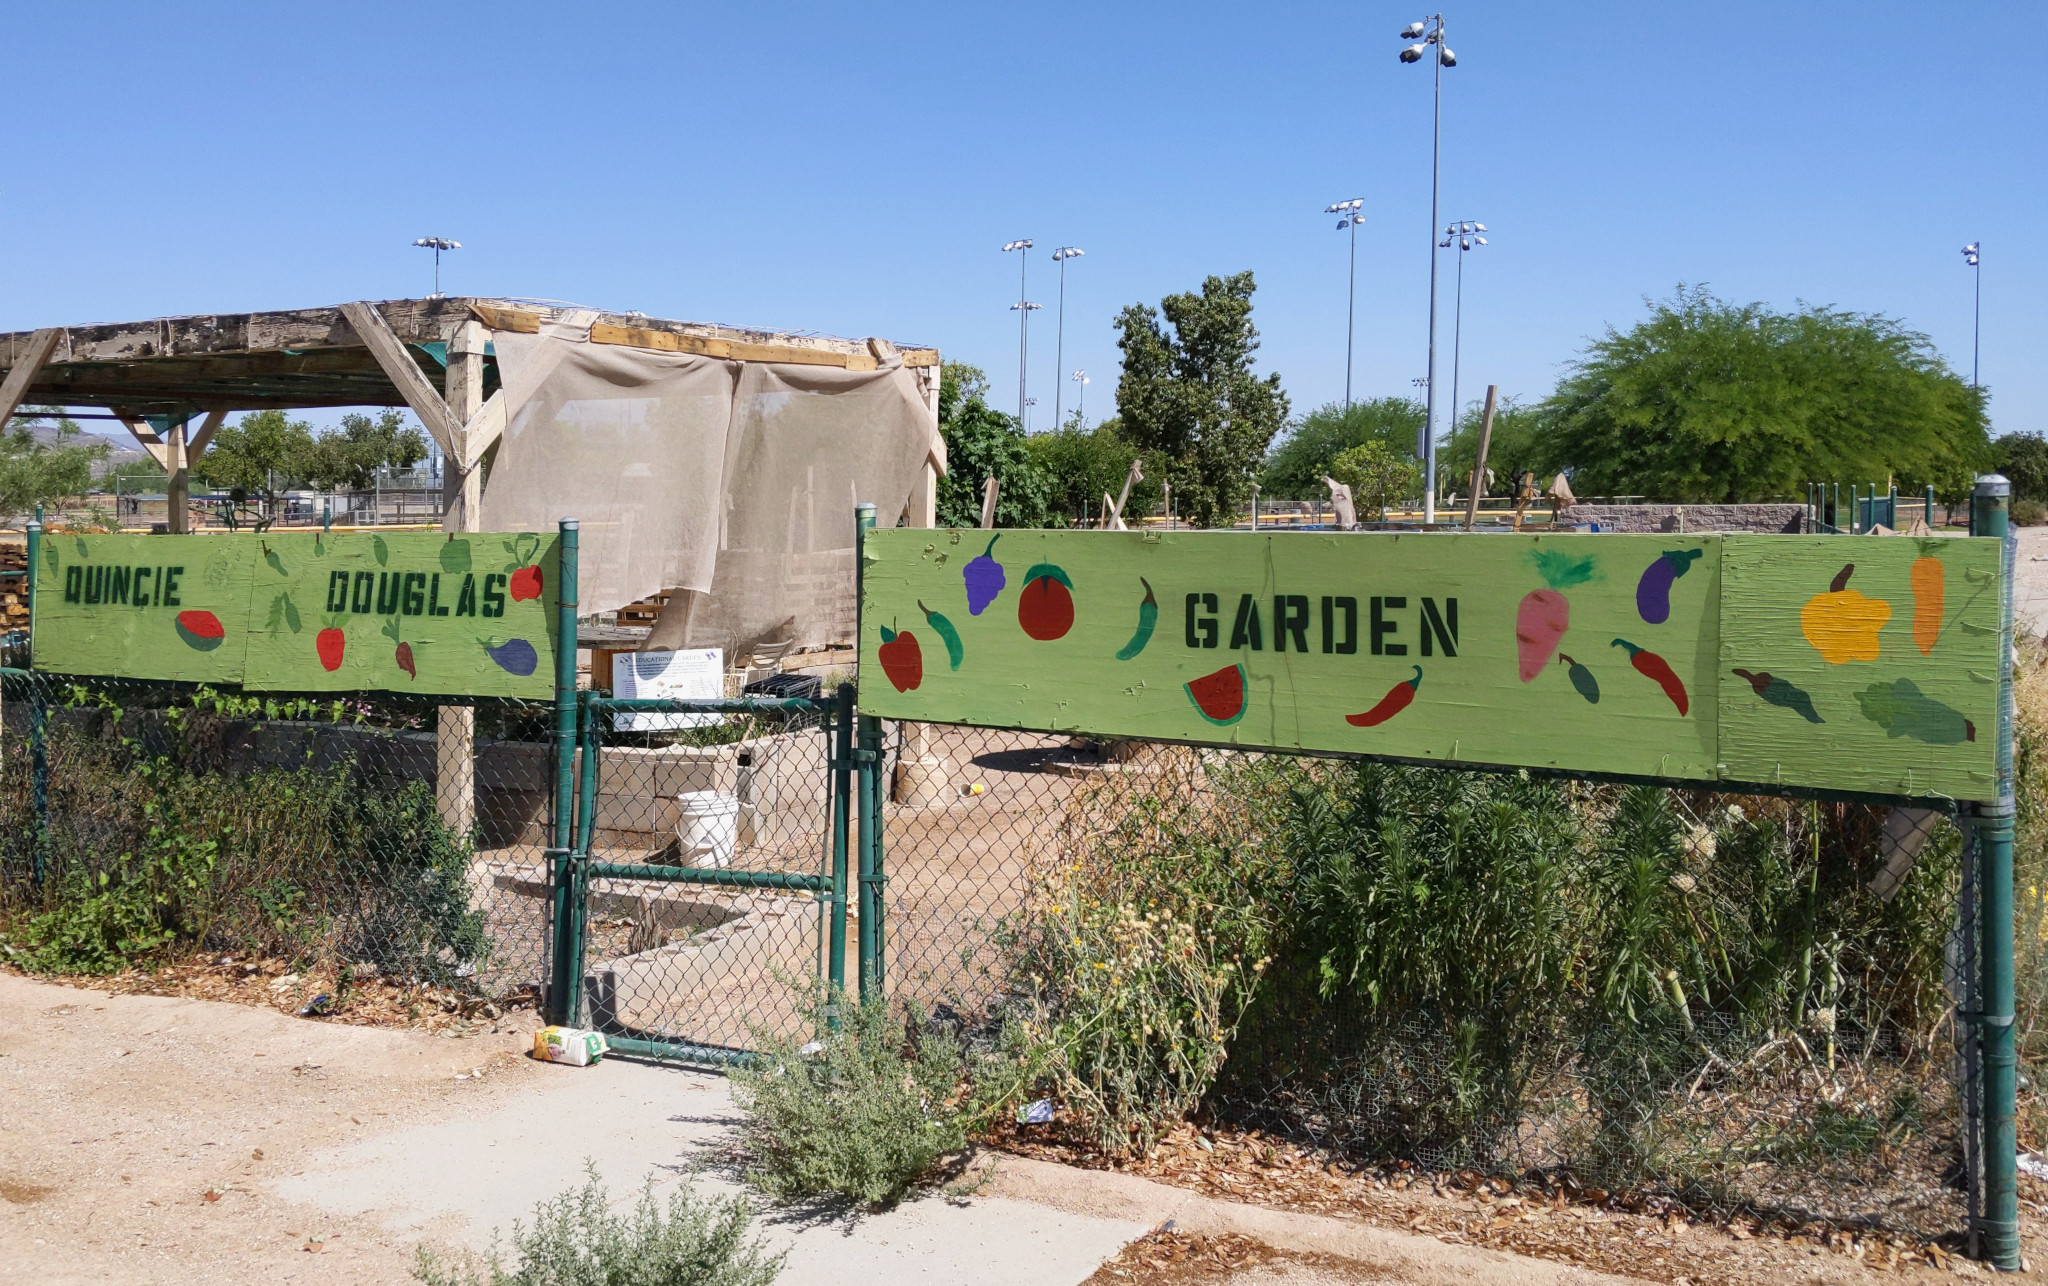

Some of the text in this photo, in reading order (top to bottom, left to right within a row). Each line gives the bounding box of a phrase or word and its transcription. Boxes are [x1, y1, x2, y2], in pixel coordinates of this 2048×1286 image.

[65, 566, 507, 618] QUINCIE DOUGLAS
[1184, 592, 1459, 657] GARDEN
